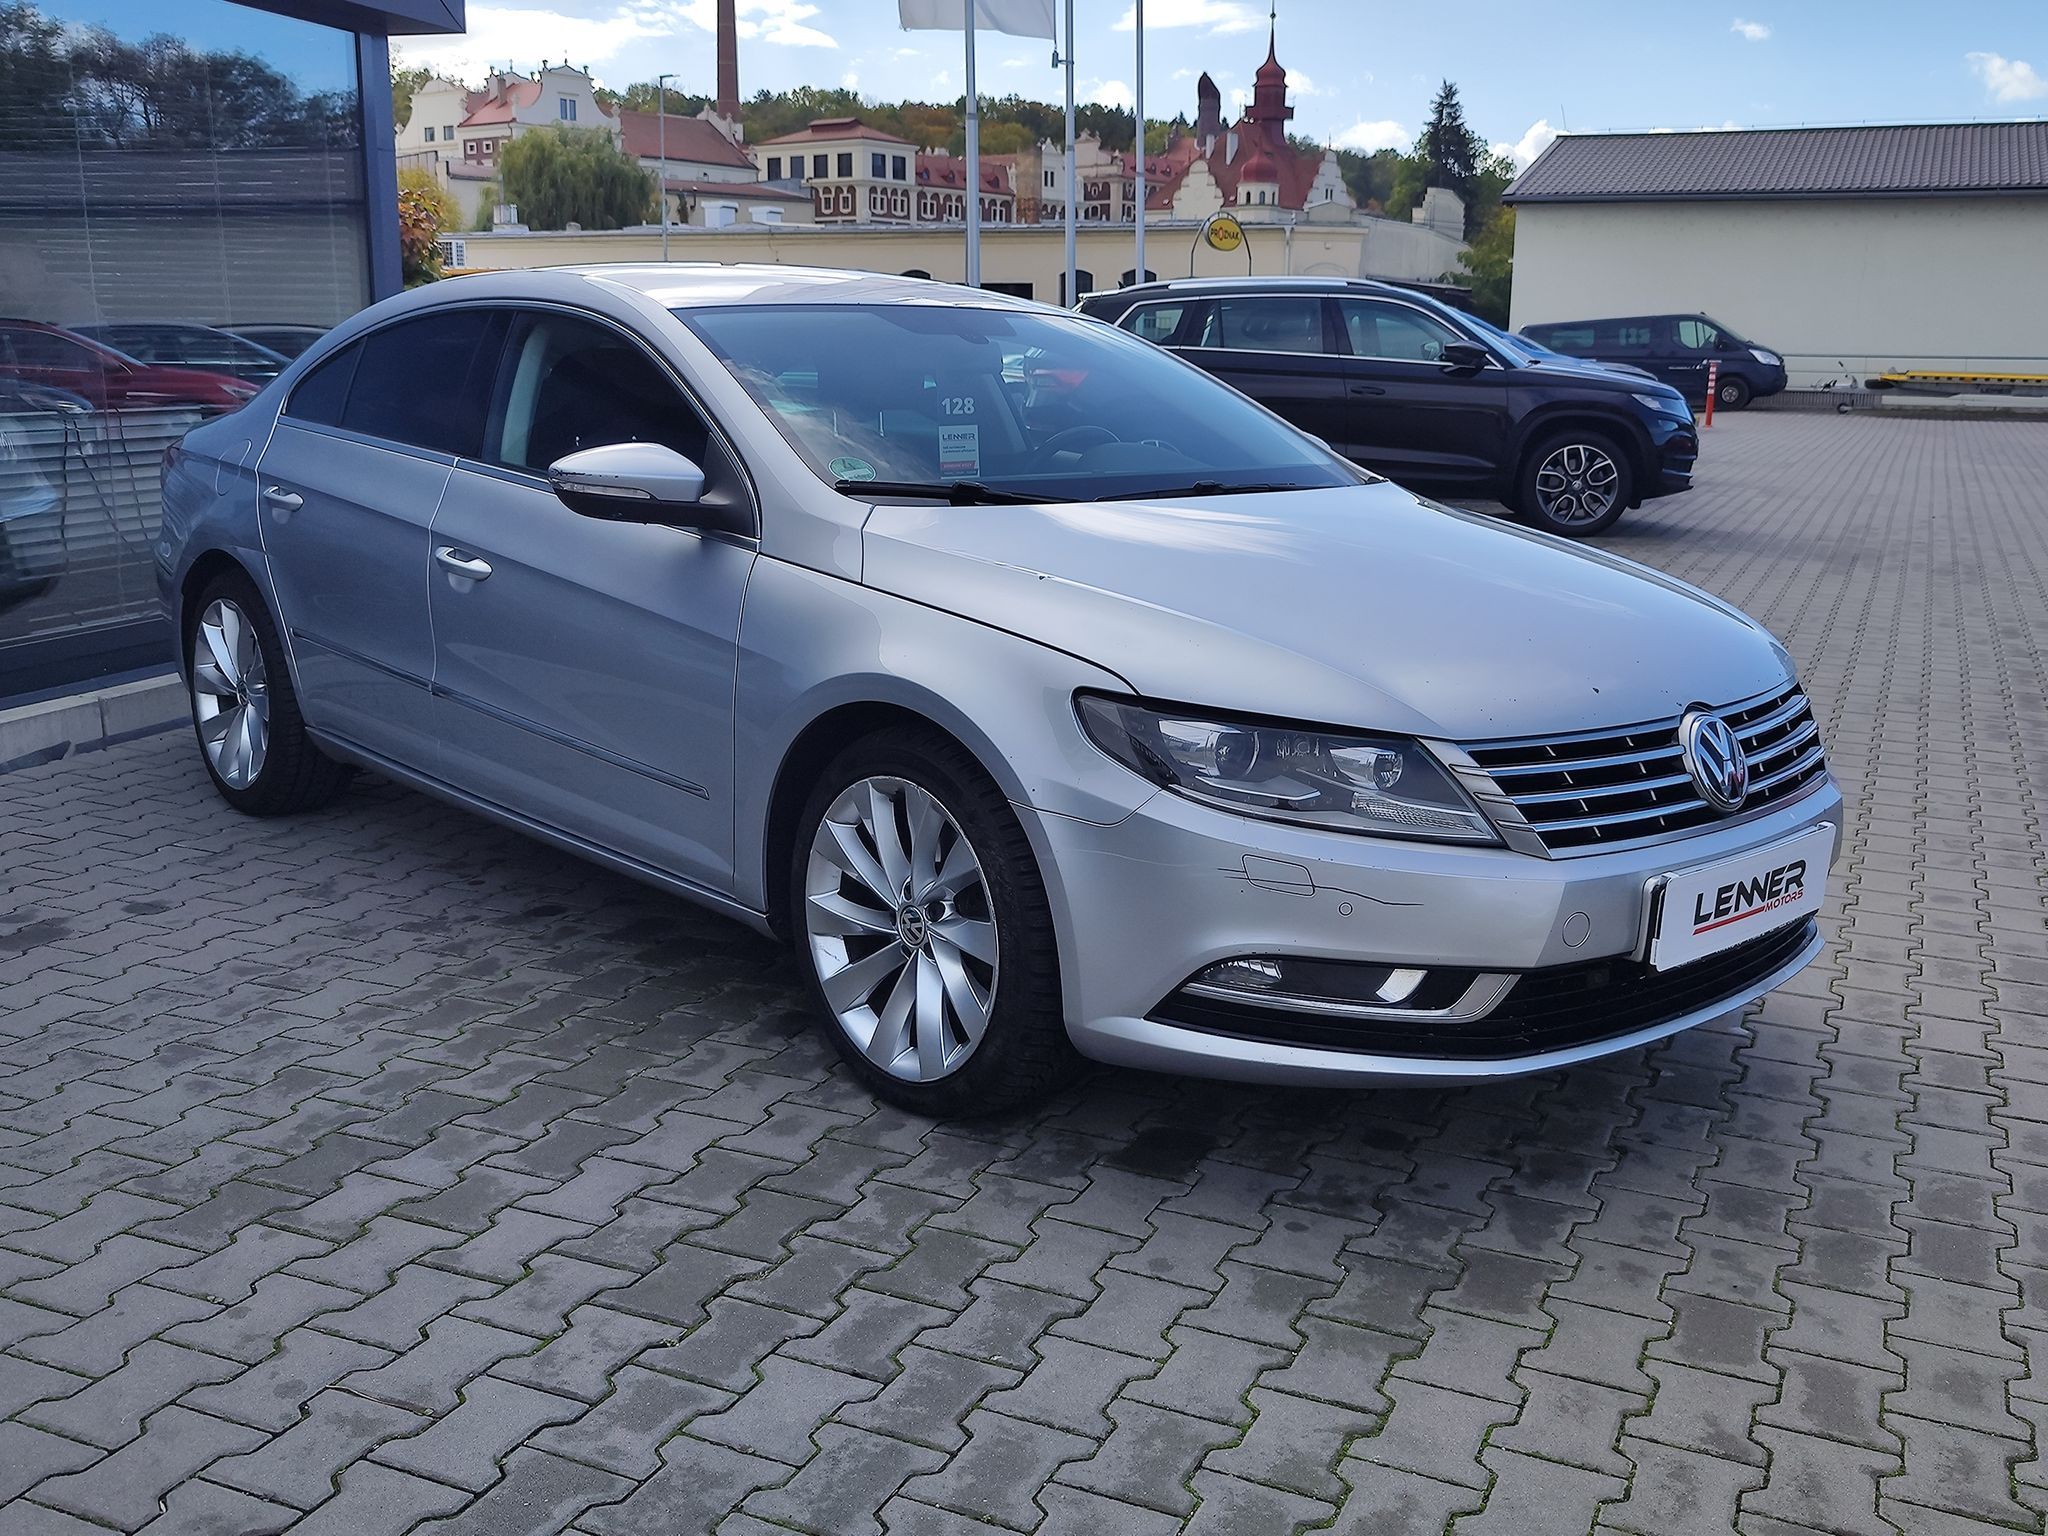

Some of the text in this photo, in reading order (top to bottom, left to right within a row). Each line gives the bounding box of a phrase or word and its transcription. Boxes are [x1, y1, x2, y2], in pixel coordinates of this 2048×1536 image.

[941, 397, 975, 415] 128
[942, 432, 976, 441] LENNER
[1693, 859, 1807, 926] LENNER
[1764, 887, 1804, 913] MOTORS
